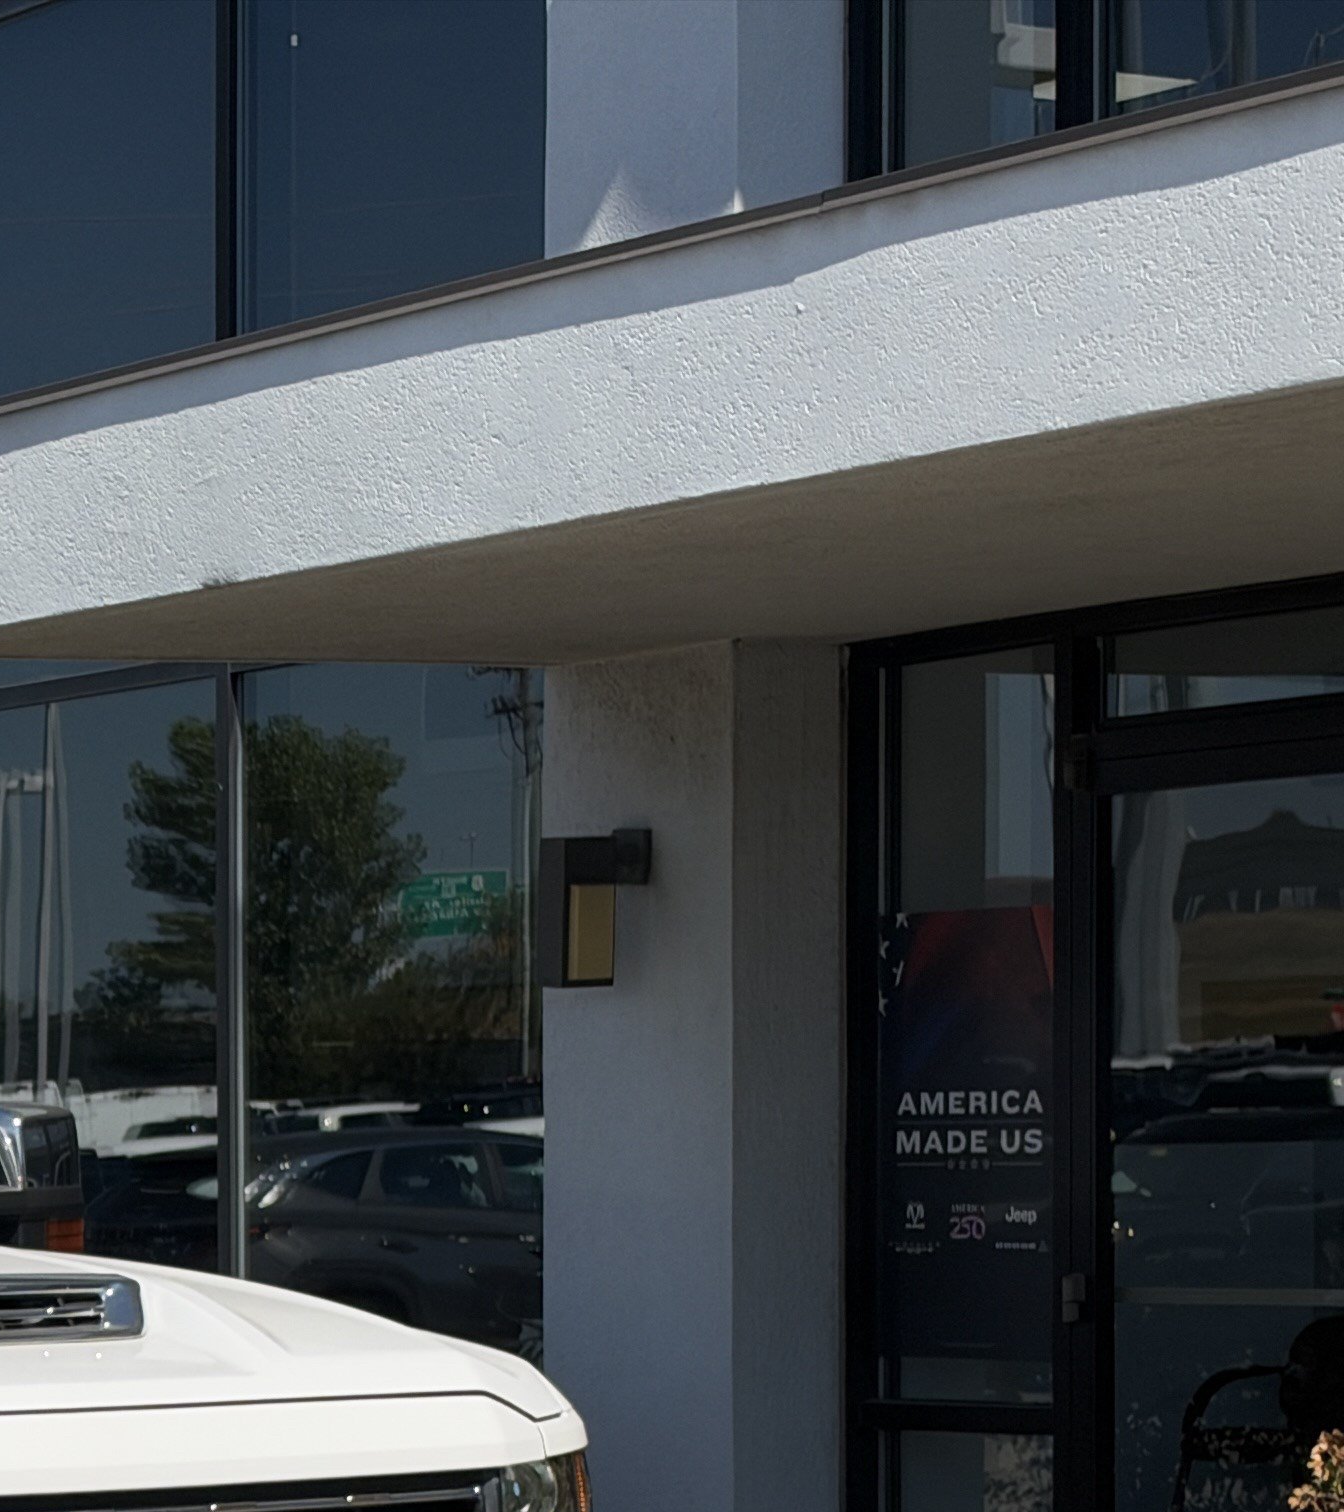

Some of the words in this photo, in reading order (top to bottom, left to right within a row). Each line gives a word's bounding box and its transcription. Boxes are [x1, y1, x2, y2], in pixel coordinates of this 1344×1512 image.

[897, 1090, 1044, 1116] AMERICA
[896, 1130, 988, 1155] MADE
[999, 1128, 1044, 1155] US
[1004, 1205, 1038, 1226] Jeep
